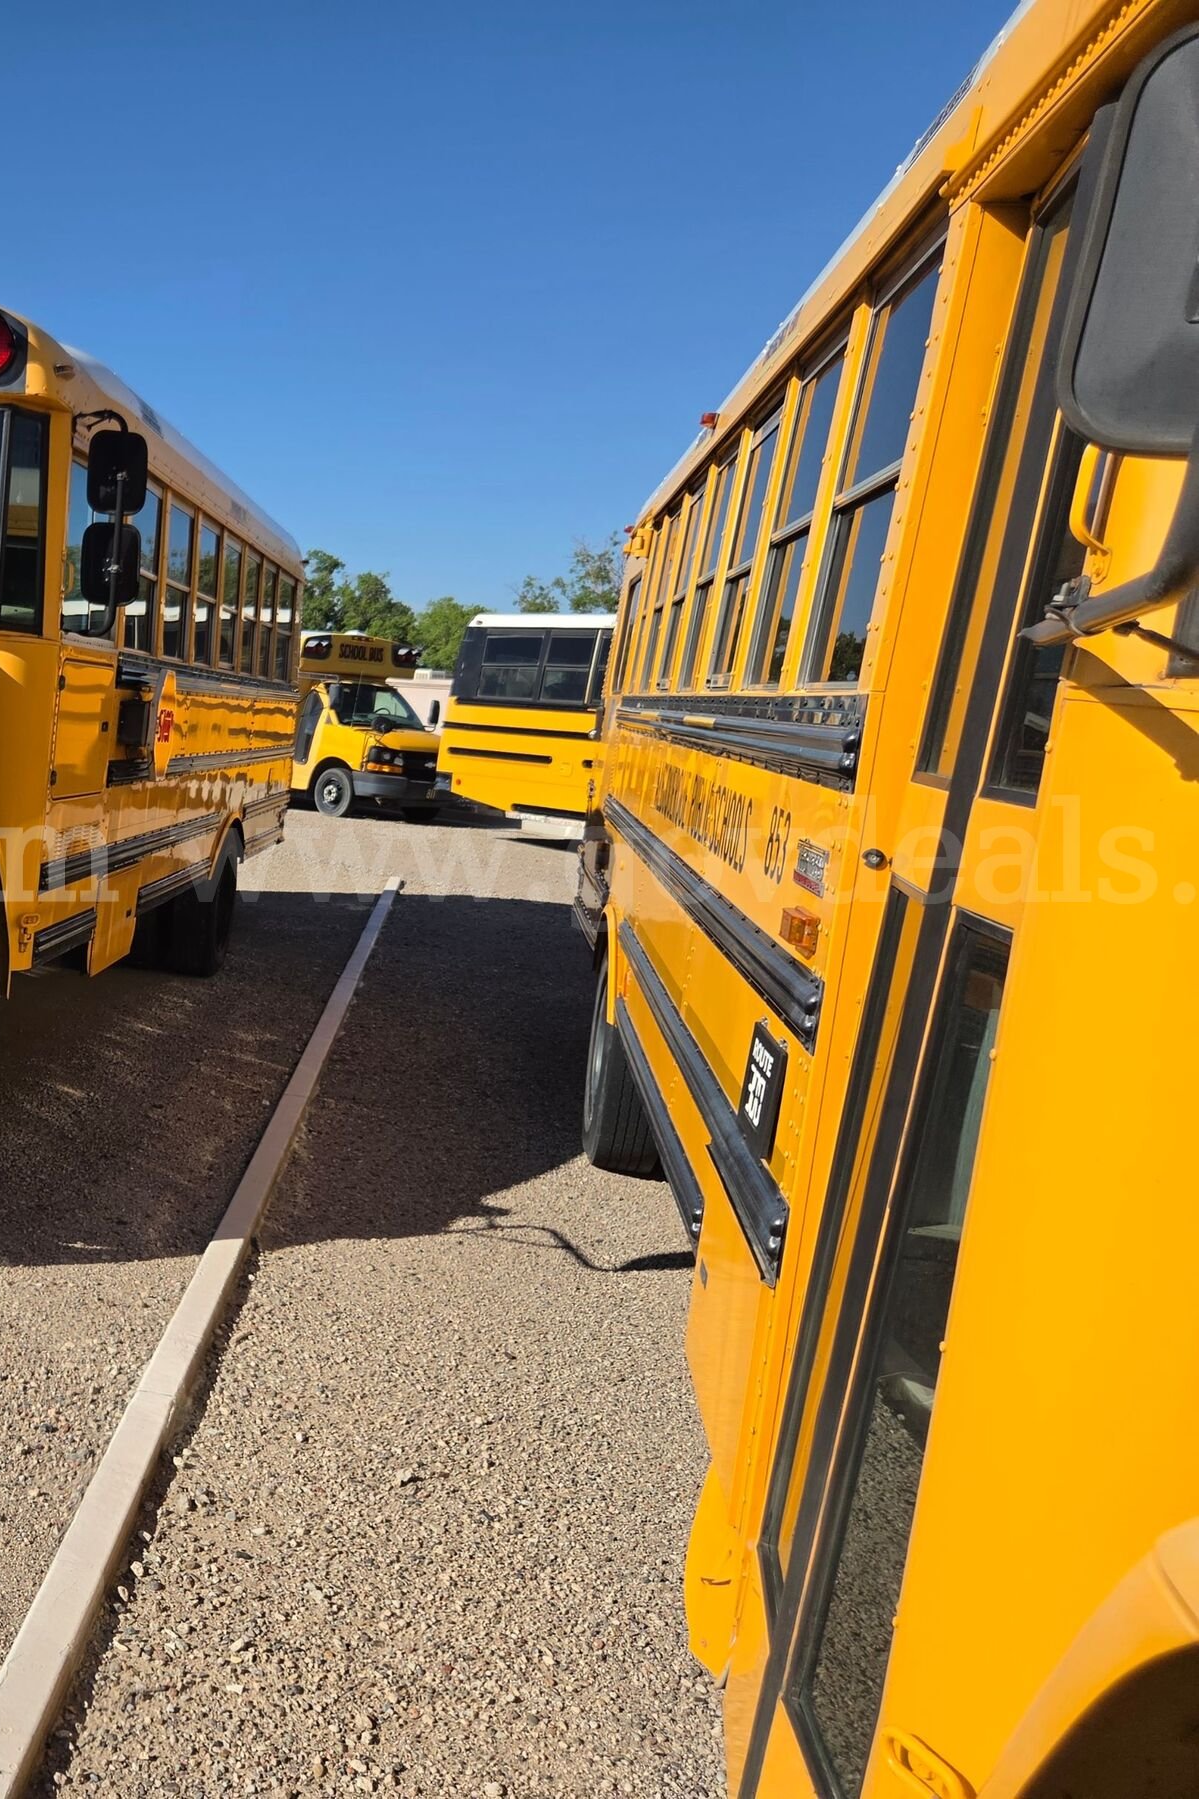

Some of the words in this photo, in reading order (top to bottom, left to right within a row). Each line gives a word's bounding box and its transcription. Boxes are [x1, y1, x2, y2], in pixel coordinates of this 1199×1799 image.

[339, 643, 367, 661] SCHOOL
[368, 647, 384, 663] BUS
[764, 805, 792, 886] 853
[751, 1037, 775, 1079] ROUTE
